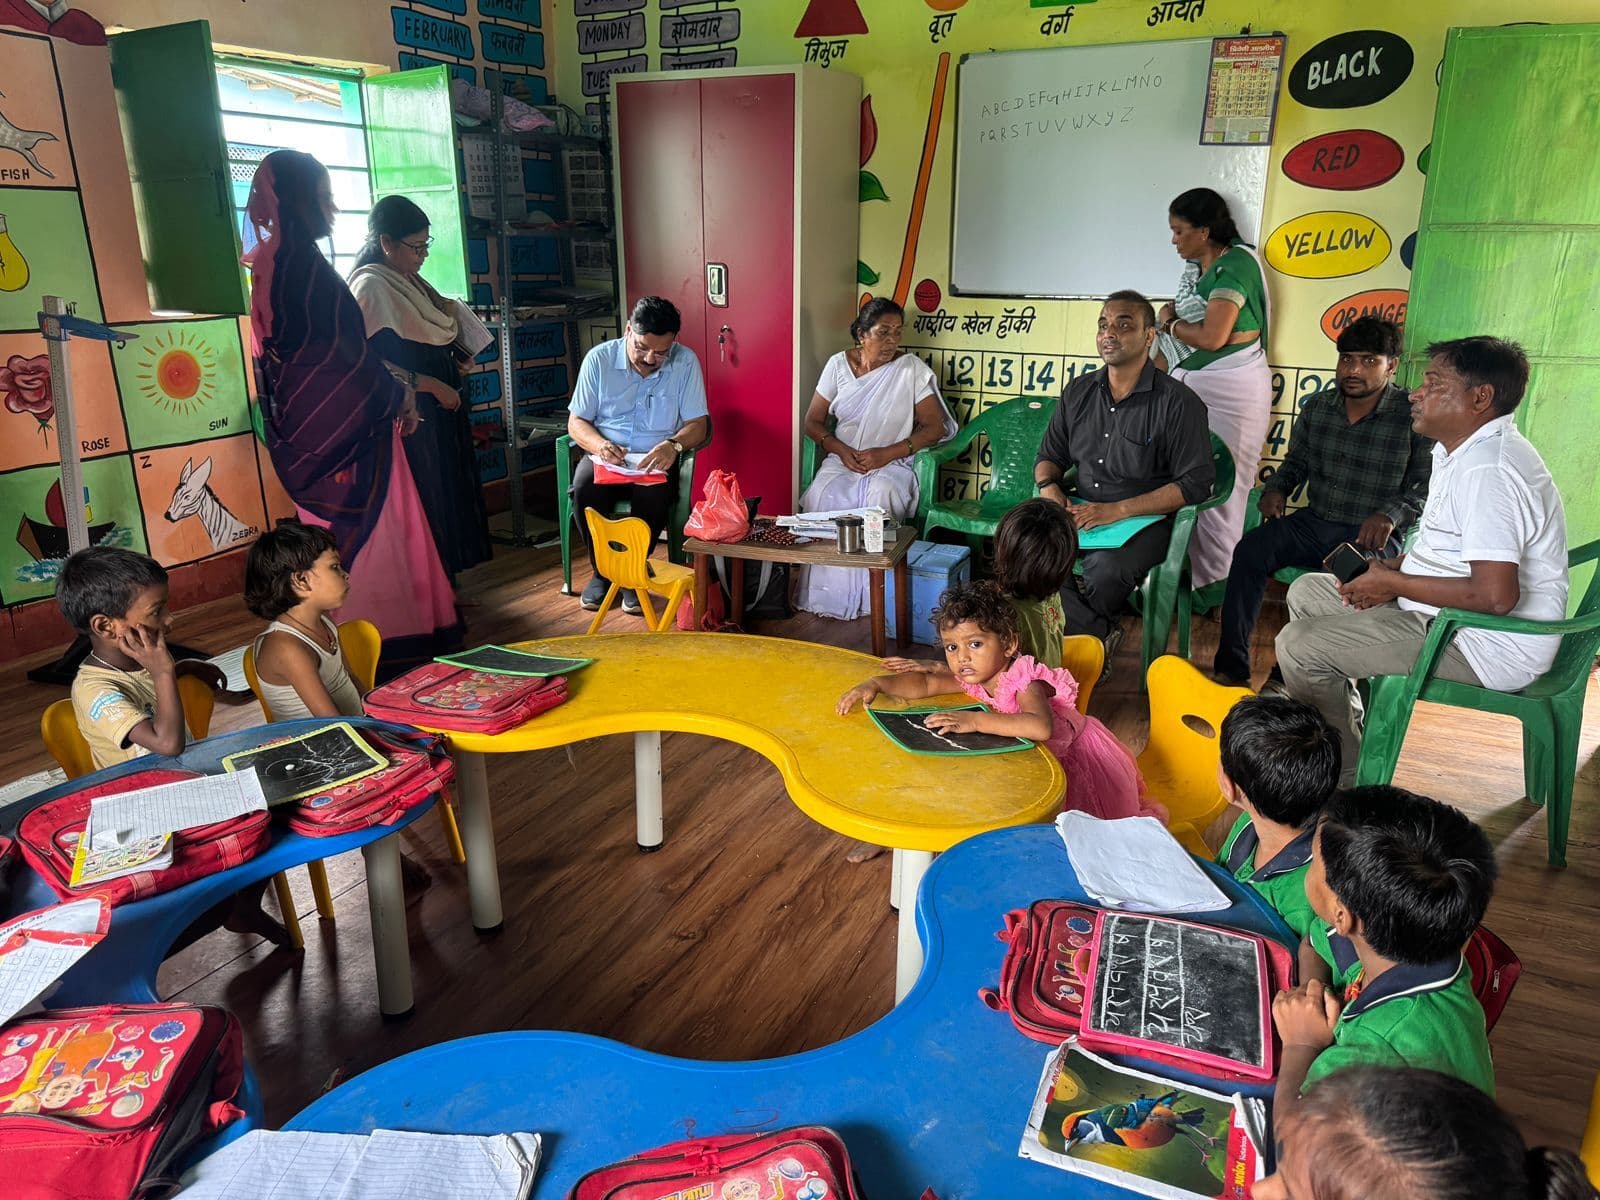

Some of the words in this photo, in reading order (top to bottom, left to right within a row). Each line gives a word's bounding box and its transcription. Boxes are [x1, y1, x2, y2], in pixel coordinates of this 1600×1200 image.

[1040, 6, 1075, 36] वर्ग
[1147, 0, 1205, 27] आयत
[404, 16, 467, 53] FEBRUARY
[585, 21, 632, 46] MONDAY
[671, 16, 723, 44] सोमवार
[804, 37, 849, 69] त्रिभुज
[586, 64, 637, 89] TUES
[1307, 47, 1384, 91] BLACK
[1311, 143, 1361, 174] RED
[1, 168, 30, 181] FISH
[1284, 227, 1376, 260] YELLOW
[913, 308, 958, 338] राष्ट्रीय
[961, 310, 995, 335] खेल
[996, 305, 1037, 339] हॉकी
[946, 355, 975, 387] 12
[985, 356, 1014, 387] 13
[1023, 360, 1055, 391] 14
[208, 416, 229, 432] SUN
[81, 437, 111, 453] ROSE
[139, 455, 152, 469] Z
[943, 477, 970, 500] 87
[231, 525, 259, 542] ZEBRA
